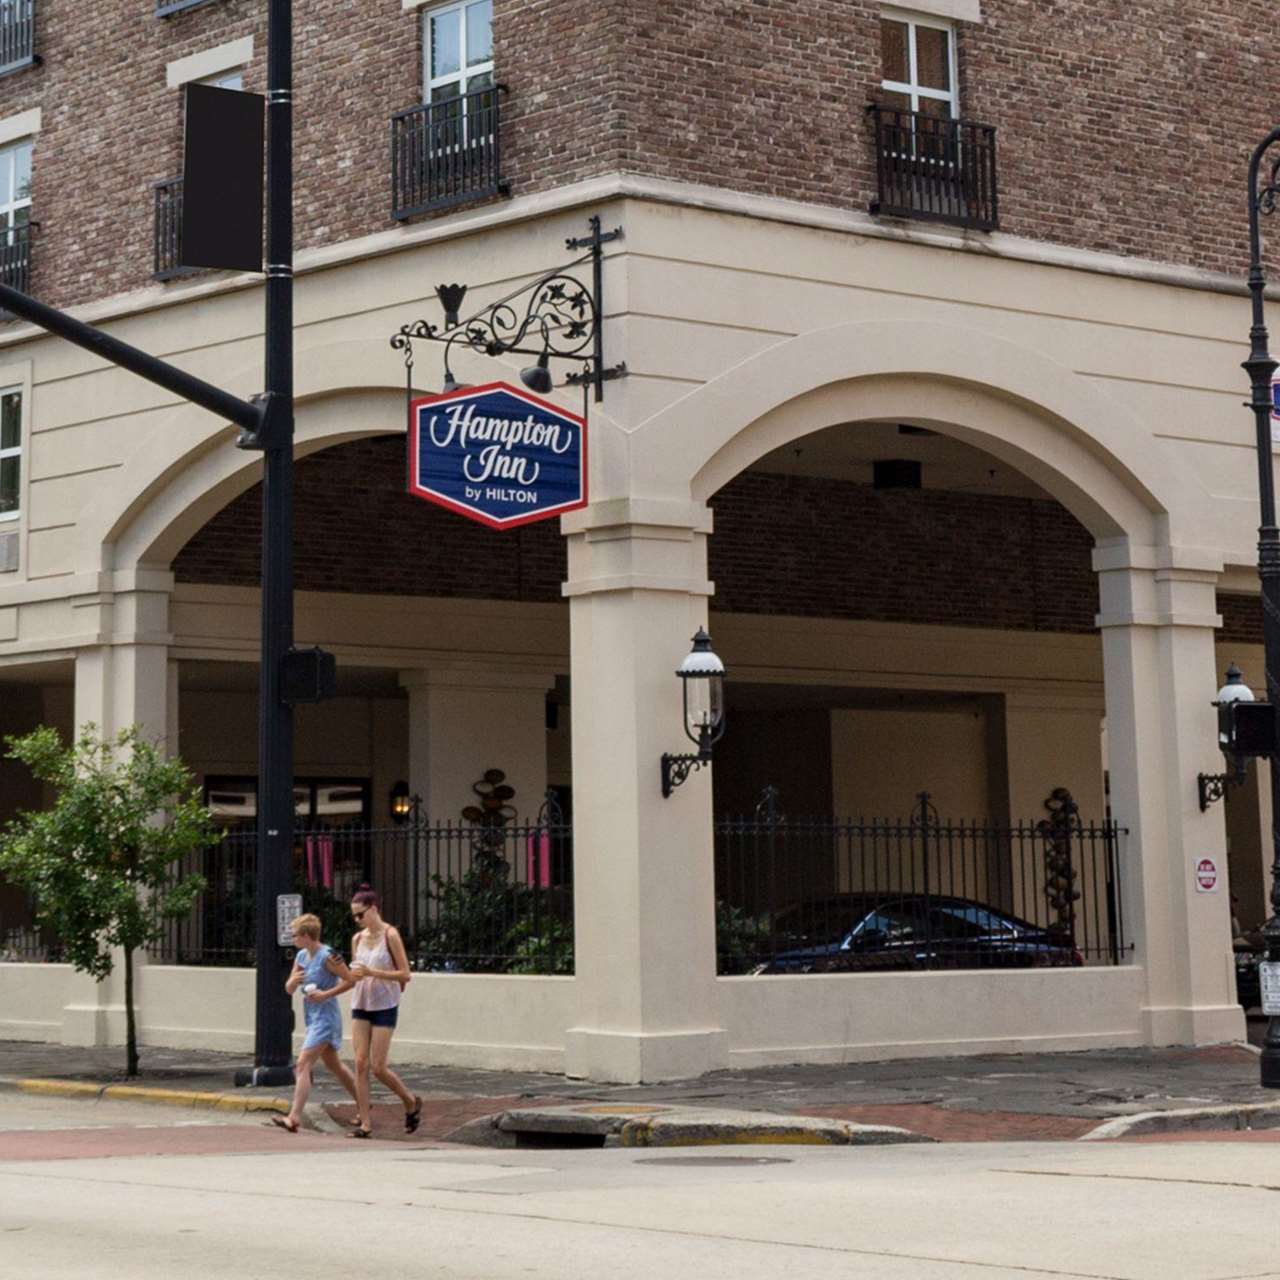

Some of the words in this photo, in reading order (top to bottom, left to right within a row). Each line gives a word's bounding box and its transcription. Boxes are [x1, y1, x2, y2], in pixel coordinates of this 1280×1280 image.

[429, 403, 572, 454] Hampton
[463, 445, 540, 485] Inn
[465, 486, 482, 501] by
[486, 487, 537, 503] HILTON
